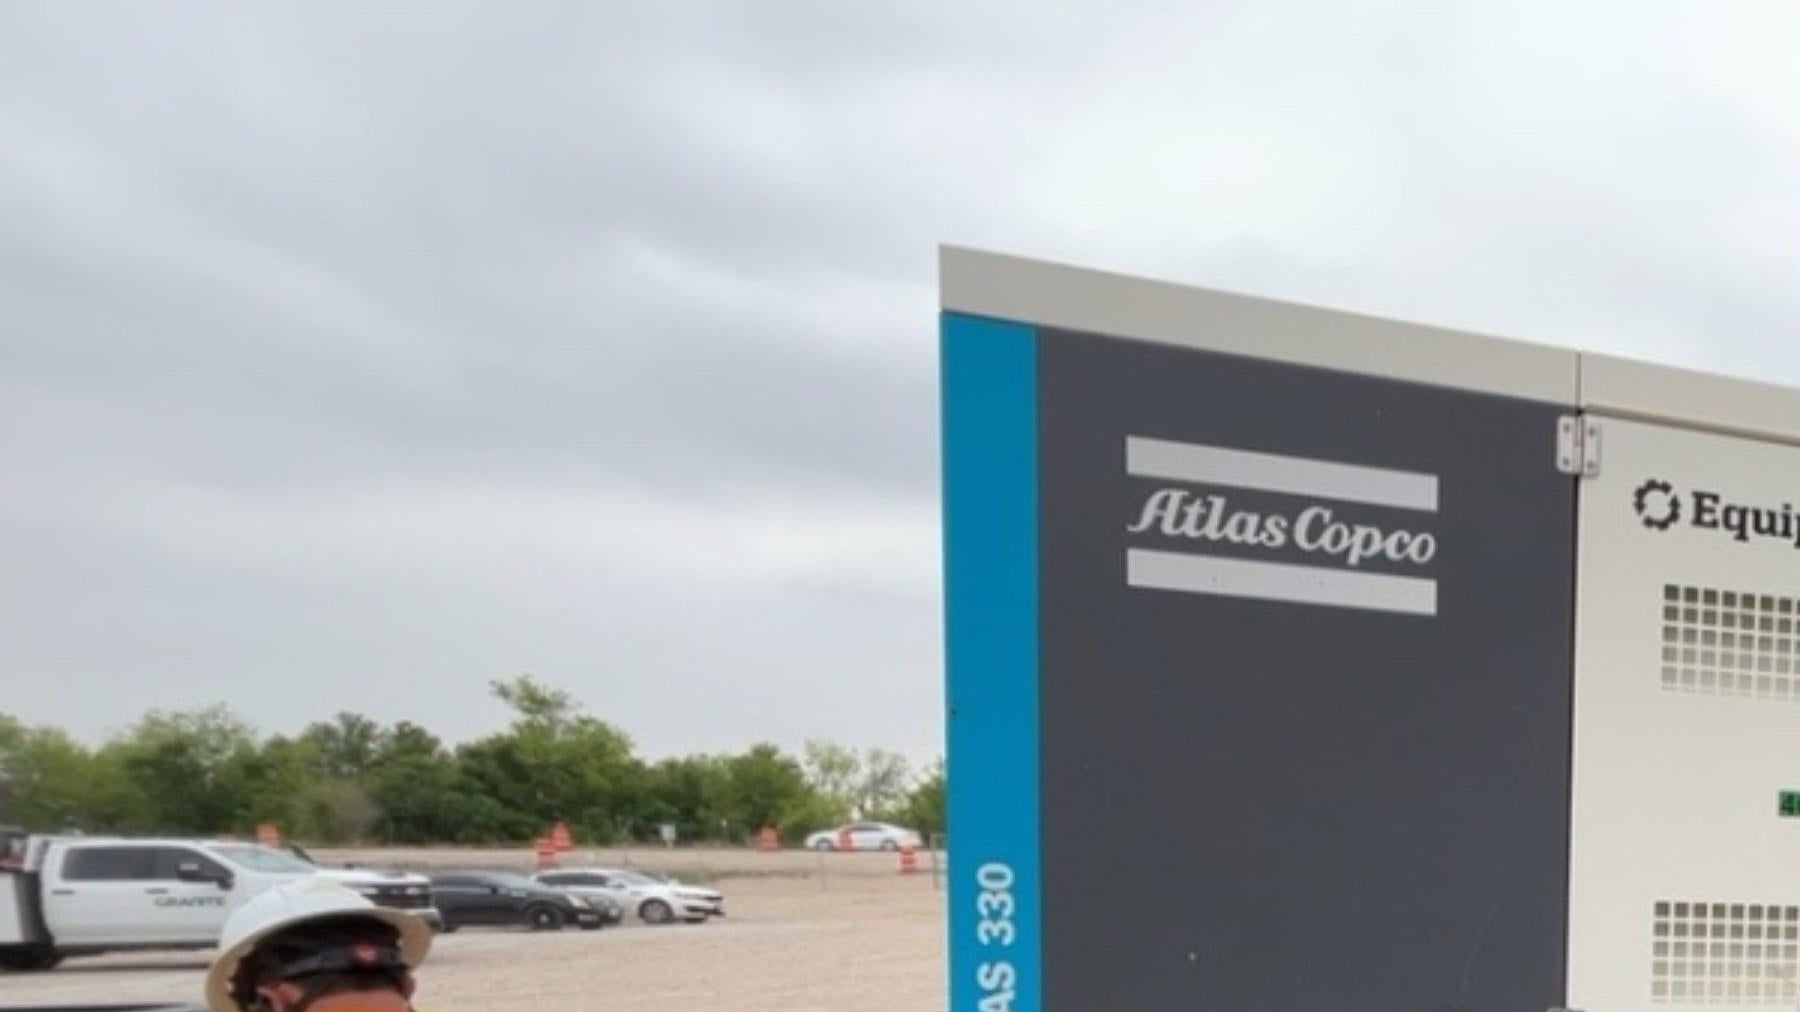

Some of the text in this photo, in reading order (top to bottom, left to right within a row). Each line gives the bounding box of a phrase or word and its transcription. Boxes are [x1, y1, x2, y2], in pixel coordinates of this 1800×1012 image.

[1127, 487, 1437, 566] Atlas Copco
[976, 862, 1016, 946] 330
